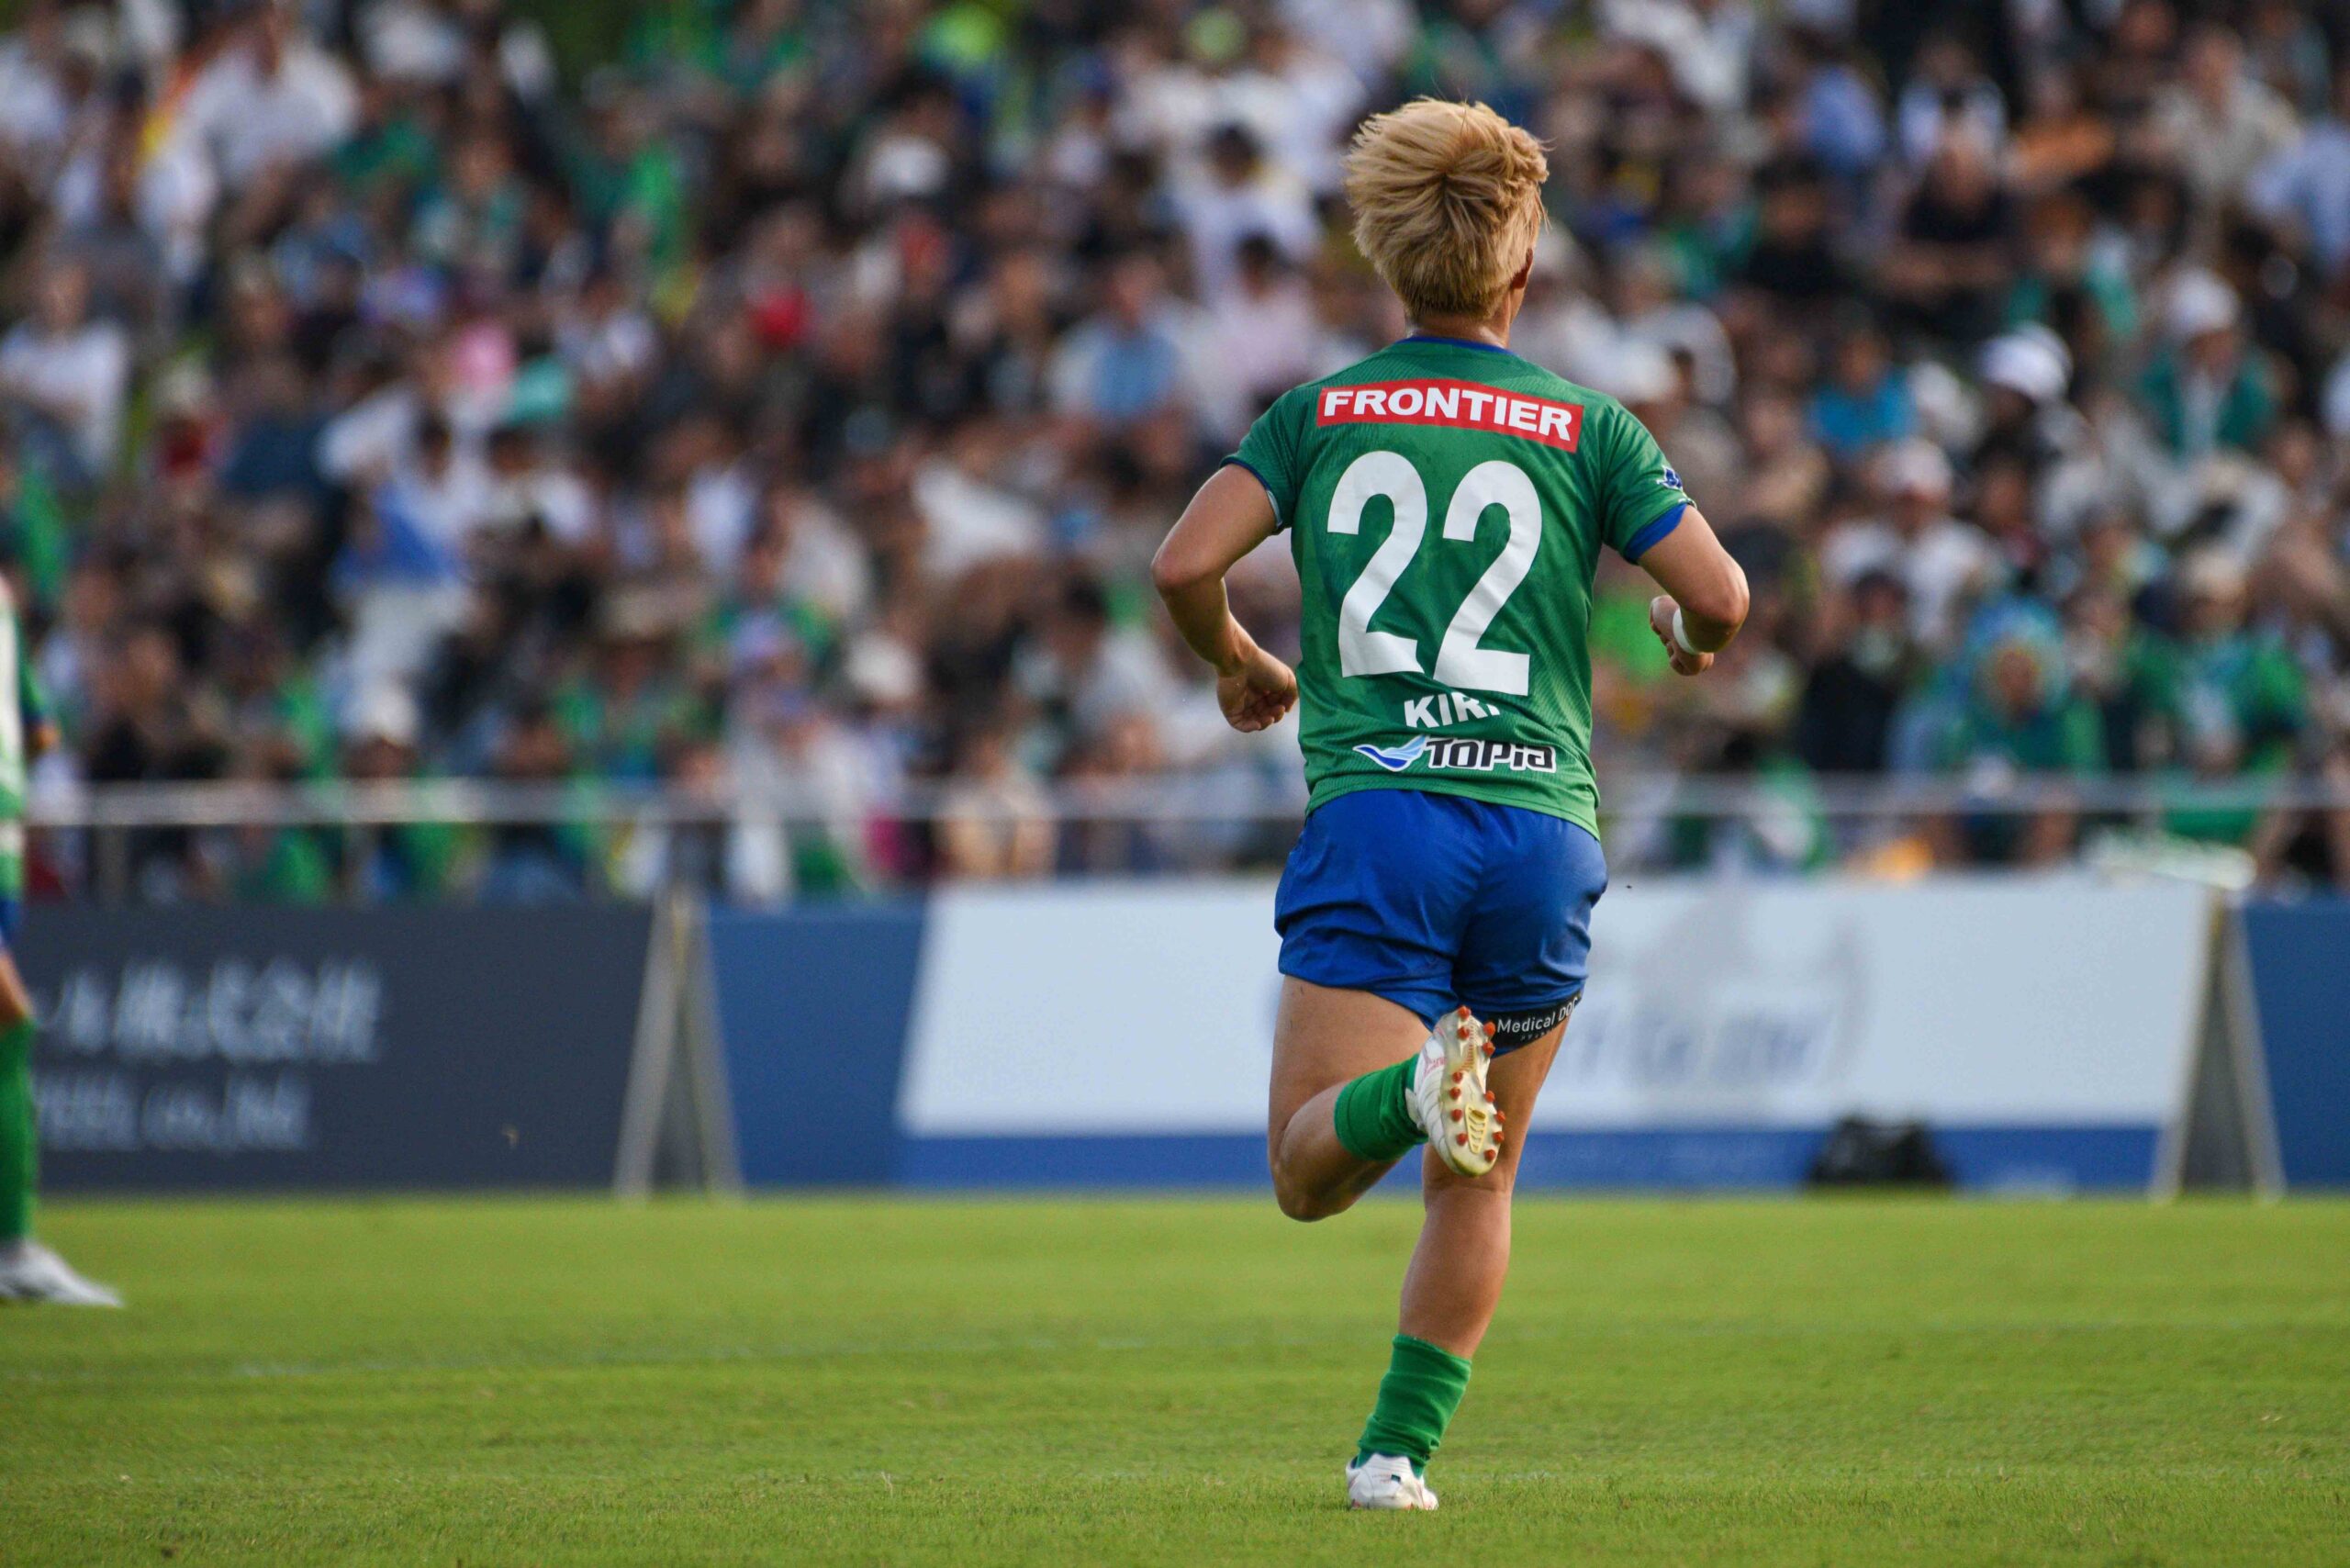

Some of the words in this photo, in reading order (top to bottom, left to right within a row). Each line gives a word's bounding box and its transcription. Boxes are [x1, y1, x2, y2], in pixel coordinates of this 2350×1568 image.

[1324, 387, 1572, 442] FRONTIER
[1327, 451, 1542, 696] 22
[1497, 1012, 1555, 1033] Medical
